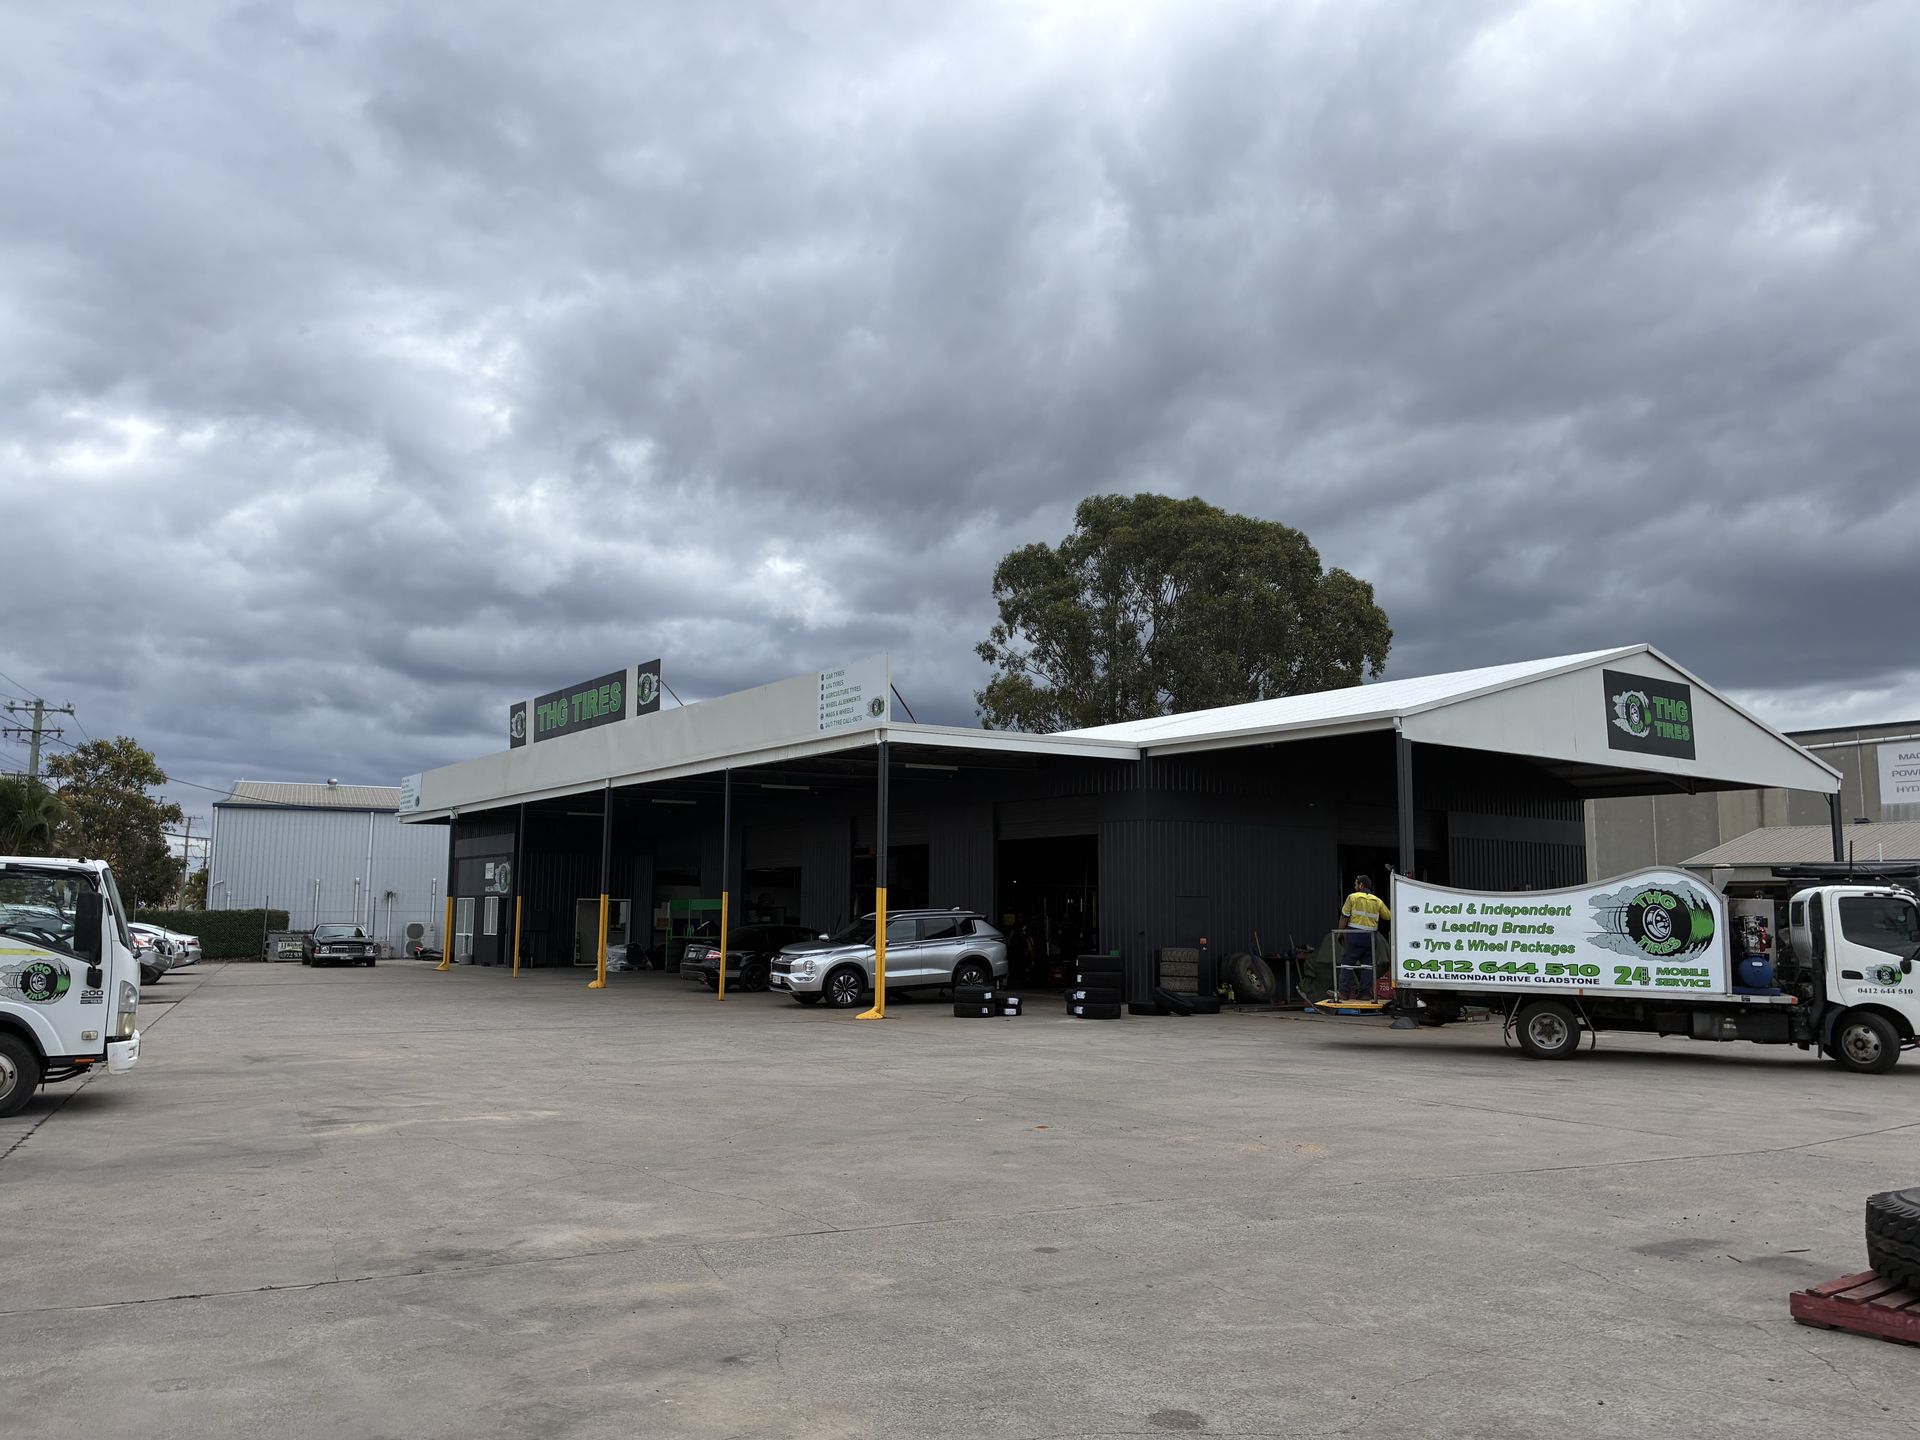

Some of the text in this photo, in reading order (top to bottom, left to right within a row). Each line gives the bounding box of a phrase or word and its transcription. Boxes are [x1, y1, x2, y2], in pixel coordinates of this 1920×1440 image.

[537, 698, 568, 732] THG
[572, 681, 622, 723] TIRES
[1652, 695, 1689, 723] THG
[1654, 720, 1690, 741] TIRES
[1632, 891, 1677, 910] THG
[1424, 902, 1572, 918] Local & Independent
[1441, 920, 1555, 936] Leading Brands
[1424, 938, 1576, 956] Tyre & Wheel Packages
[1639, 935, 1682, 954] TIRES
[26, 963, 51, 975] THG
[1402, 959, 1600, 977] 0412 644 510
[1614, 965, 1651, 985] 24
[1656, 967, 1709, 977] MOBILE
[1419, 973, 1495, 981] CALLEMONDAH
[1499, 975, 1531, 983] DRIVE
[1534, 976, 1600, 985] GLADSTONE
[1655, 977, 1711, 988] SERVICE
[25, 989, 50, 999] TIRES
